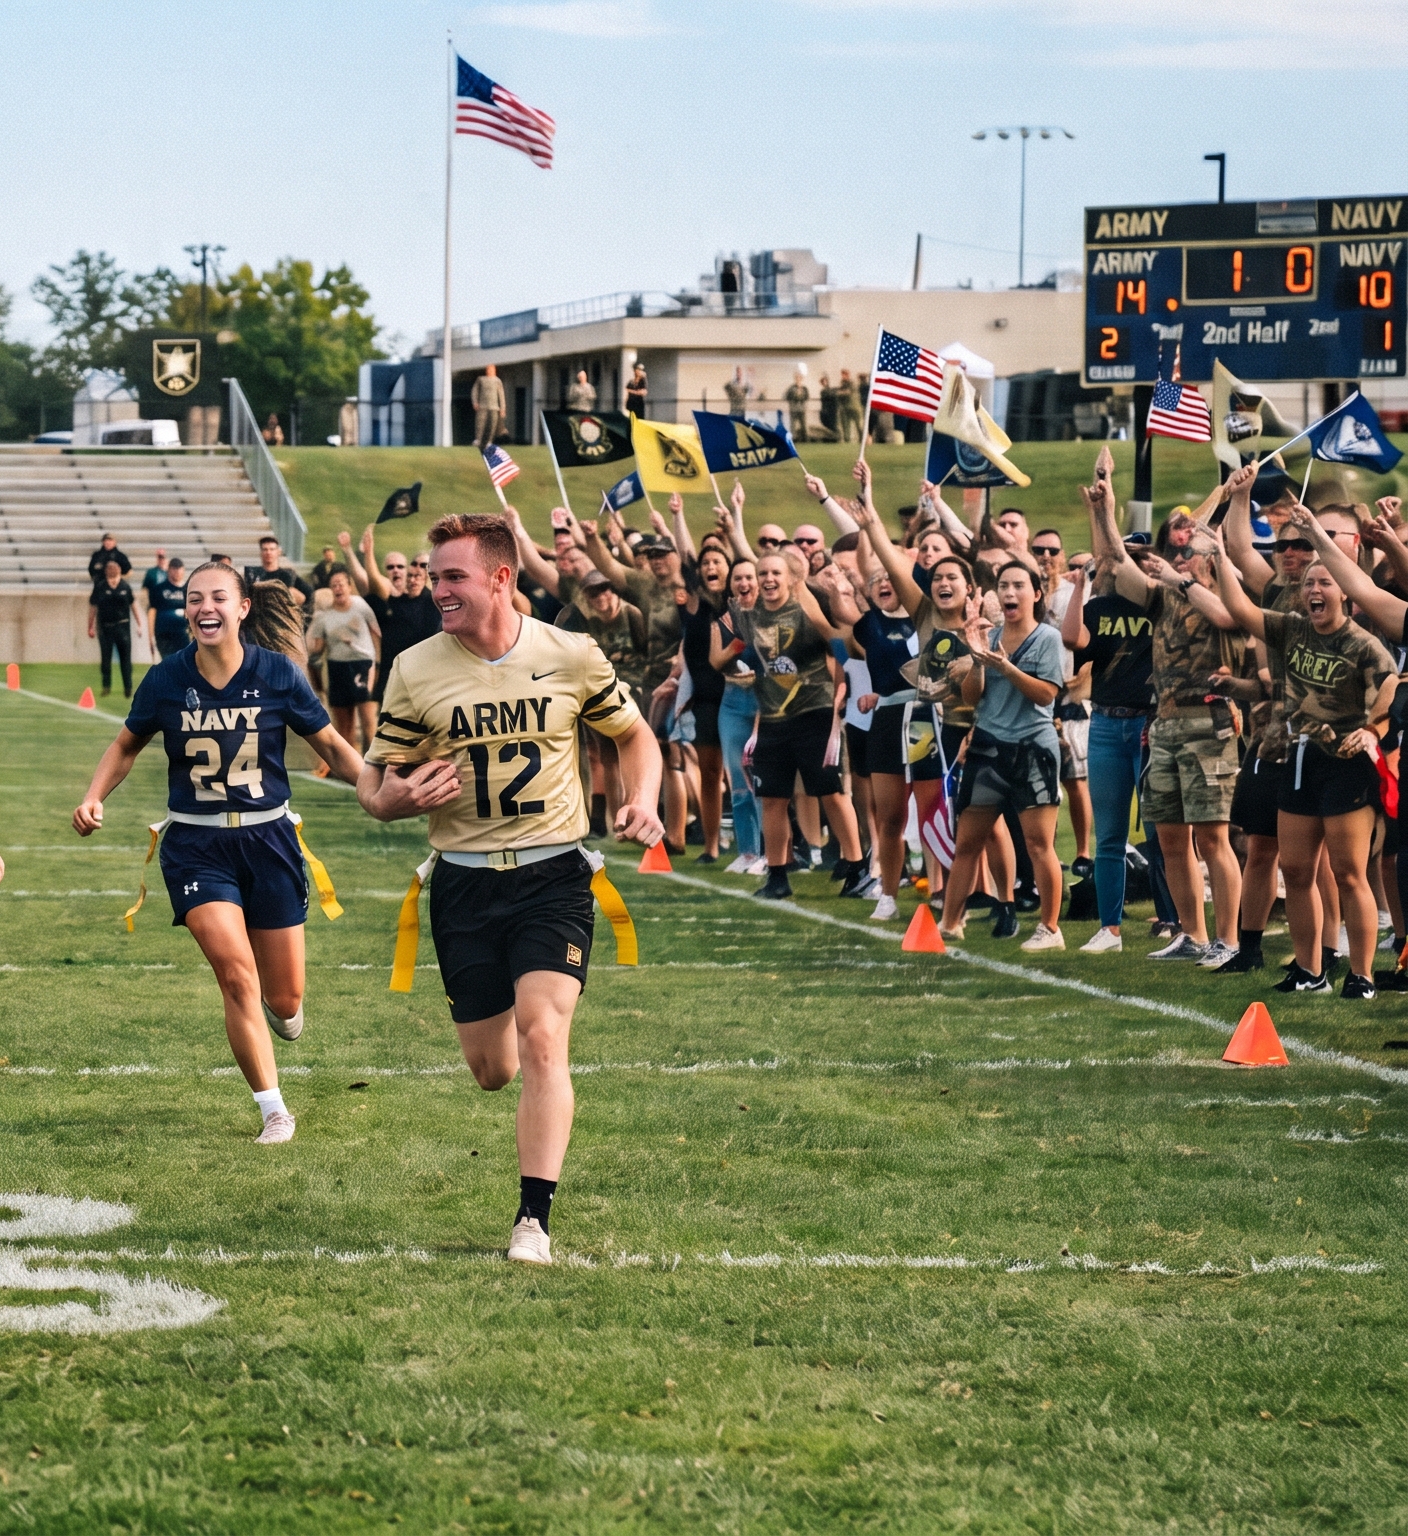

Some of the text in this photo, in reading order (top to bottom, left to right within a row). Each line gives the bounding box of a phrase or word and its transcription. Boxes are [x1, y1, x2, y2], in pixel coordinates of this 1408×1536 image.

[1094, 210, 1169, 239] ARMY
[1331, 201, 1403, 230] NAVY
[1092, 250, 1159, 275] ARMY
[1339, 241, 1403, 268] NAVY
[1115, 280, 1147, 315] 14
[1359, 271, 1393, 309] 10
[1100, 327, 1119, 359] 2
[1202, 321, 1241, 344] 2nd
[180, 707, 262, 731] NAVY
[448, 697, 552, 739] ARMY
[185, 732, 265, 801] 24
[467, 740, 545, 818] 12
